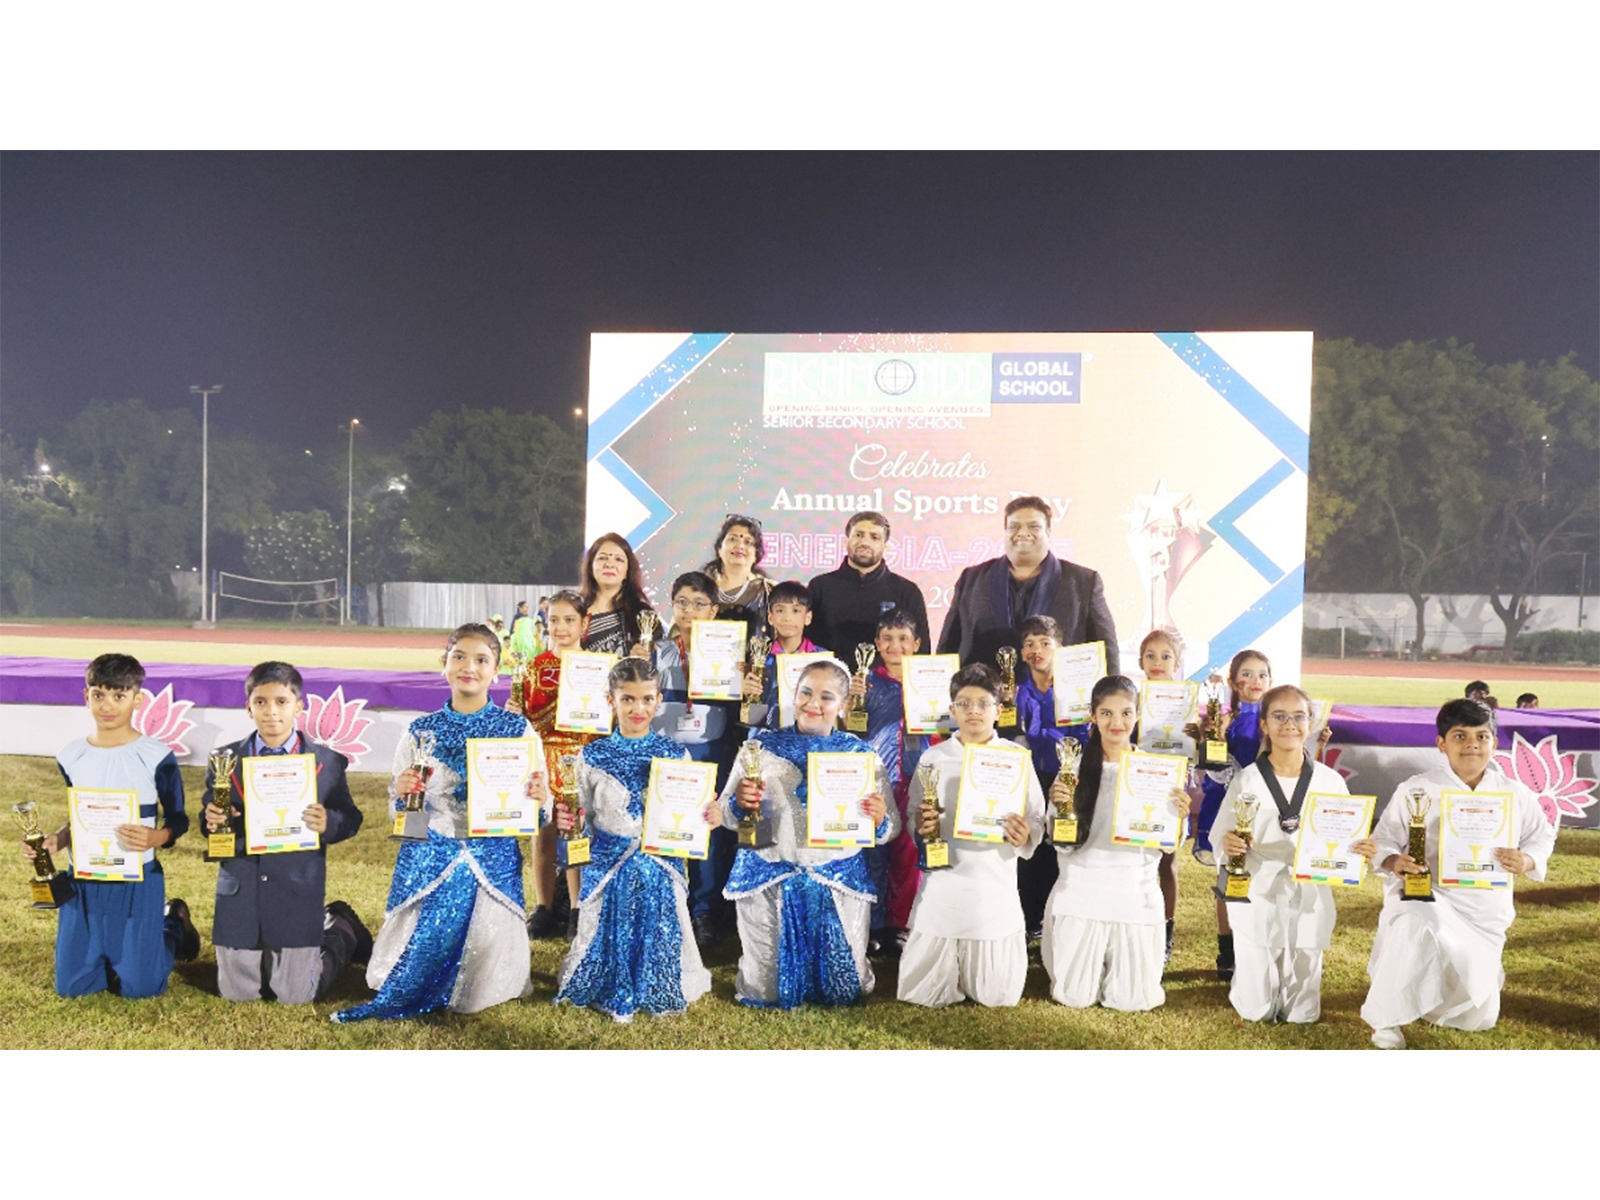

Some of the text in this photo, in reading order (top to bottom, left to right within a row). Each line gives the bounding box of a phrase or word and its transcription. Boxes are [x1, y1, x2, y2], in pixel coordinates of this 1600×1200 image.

[999, 361, 1074, 377] GLOBAL
[998, 380, 1072, 397] SCHOOL
[768, 404, 821, 413] OPENING
[870, 405, 923, 414] OPENING
[763, 415, 967, 430] SENIOR SECONDARY SCHOOL
[849, 442, 991, 482] Celebrates
[770, 487, 883, 513] Annual
[893, 488, 998, 521] Sports
